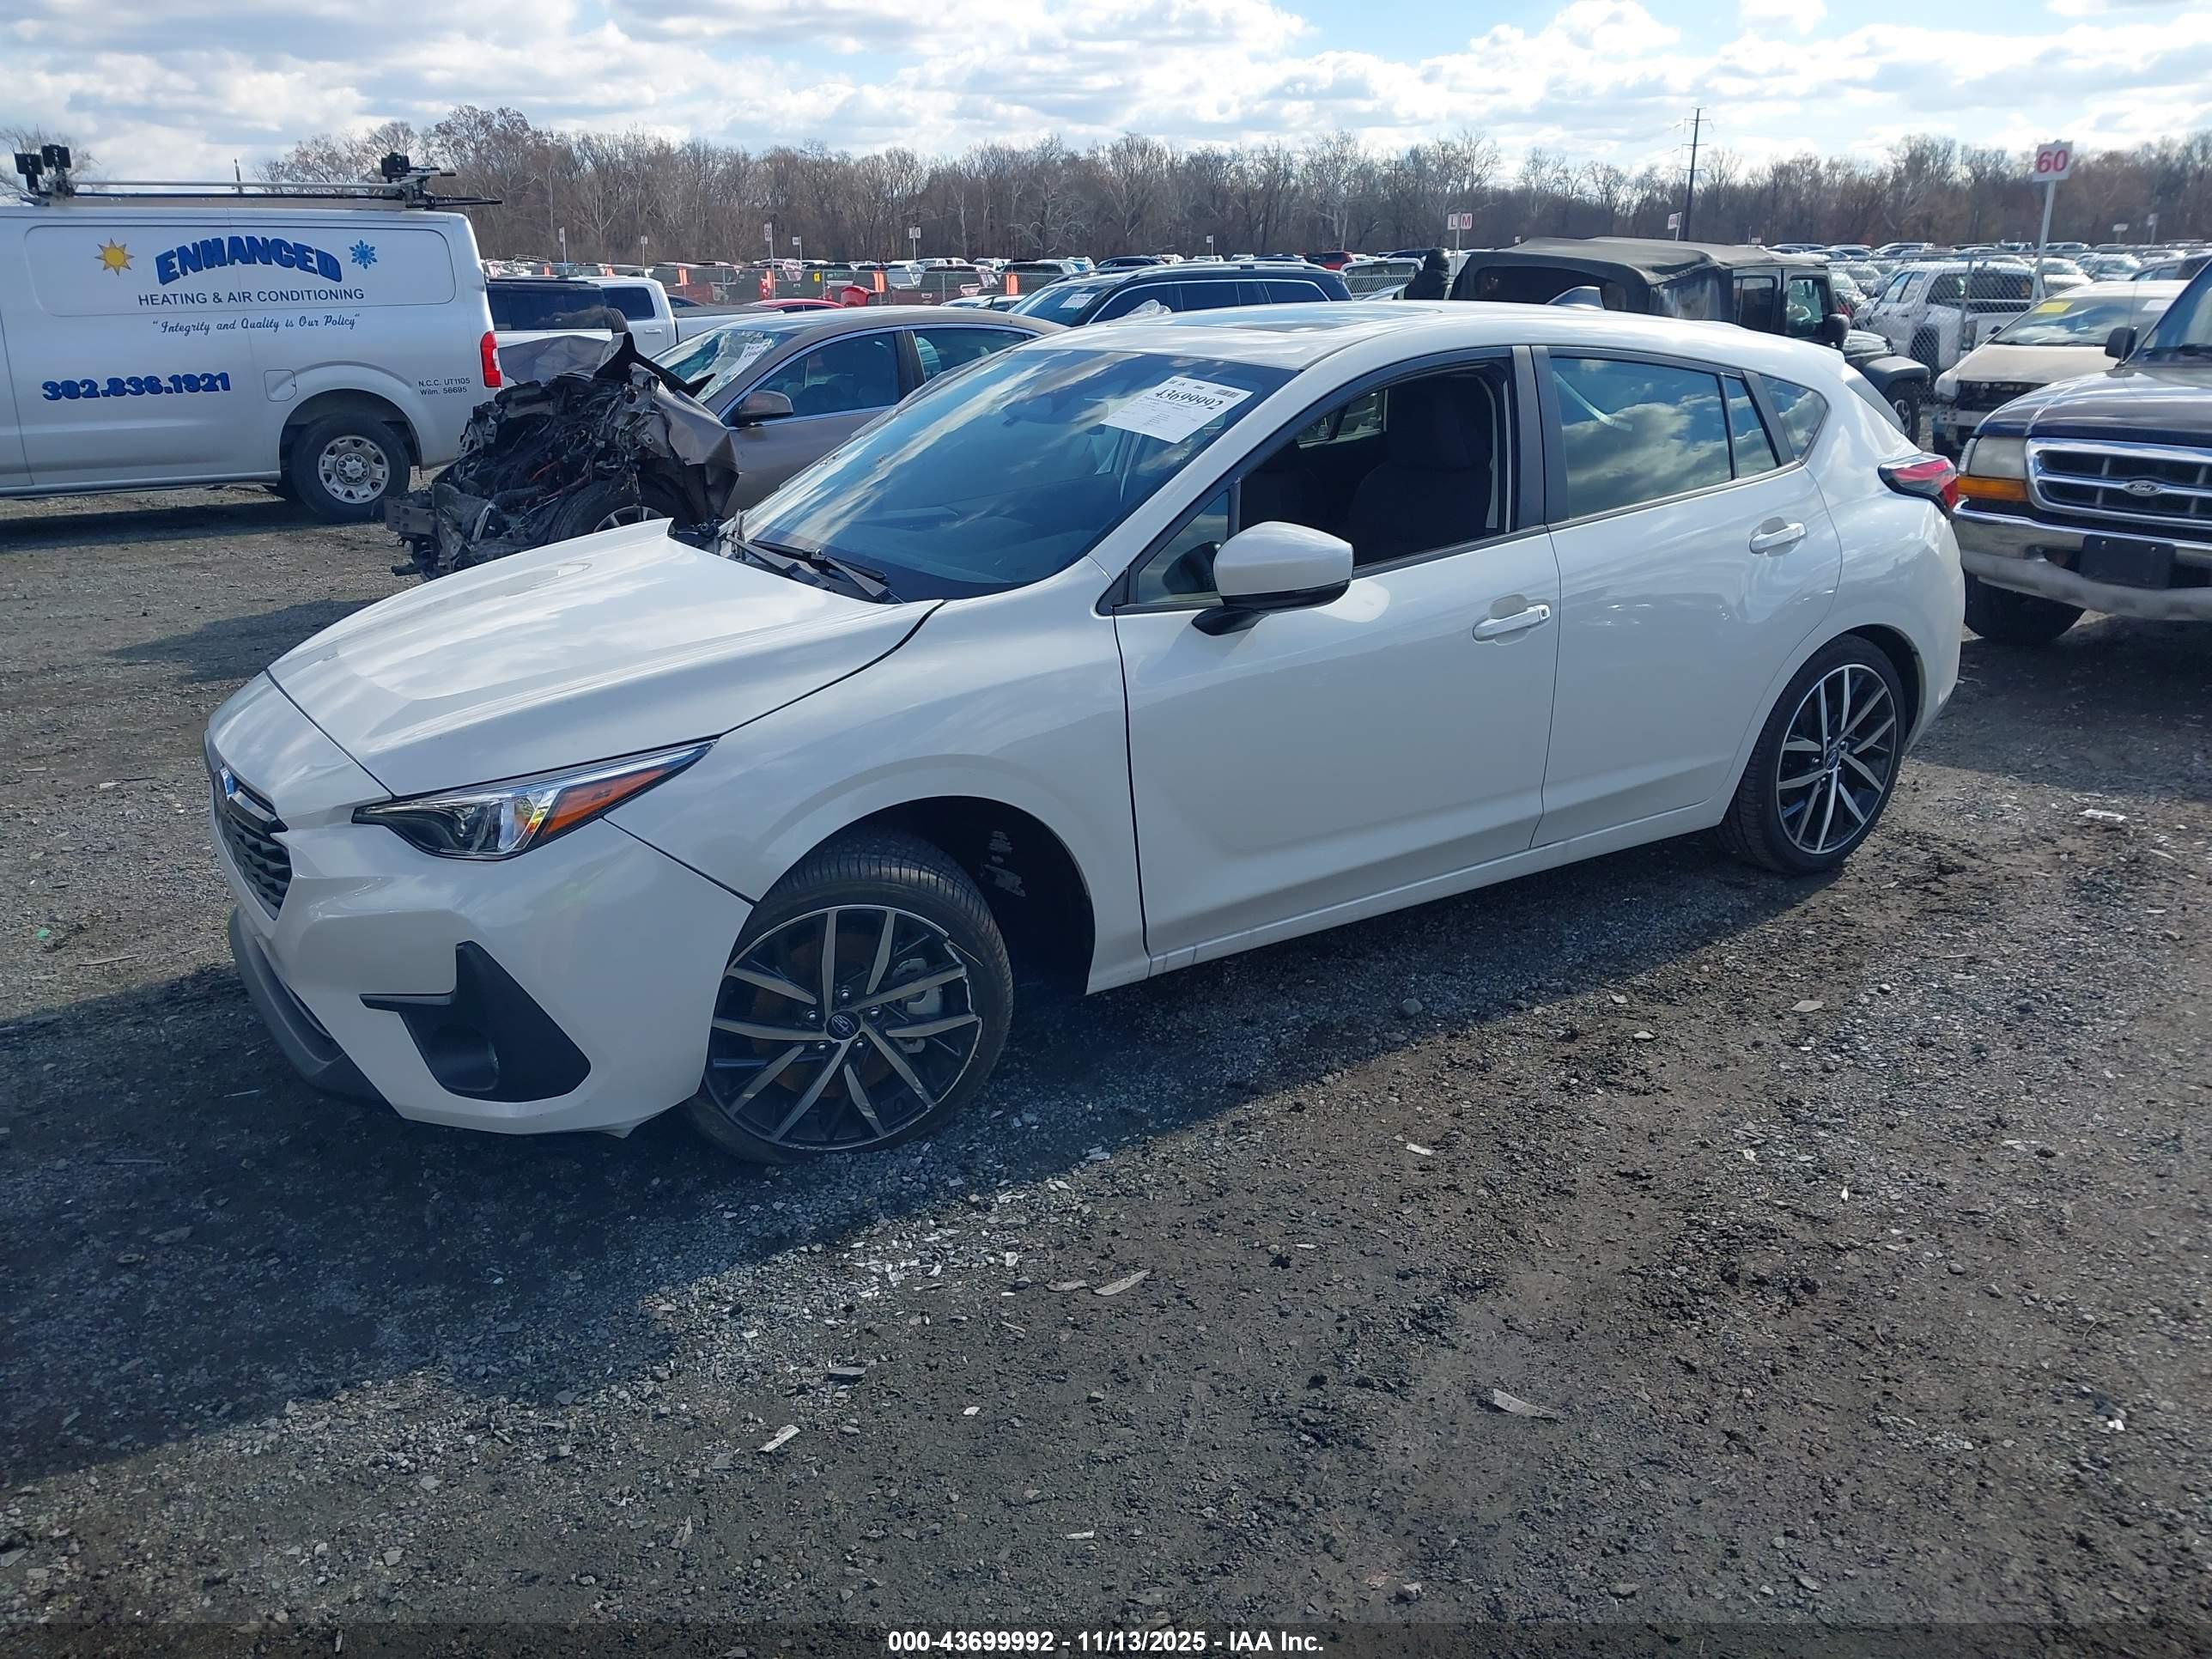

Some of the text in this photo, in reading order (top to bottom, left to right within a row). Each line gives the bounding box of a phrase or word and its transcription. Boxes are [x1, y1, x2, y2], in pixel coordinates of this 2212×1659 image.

[2037, 149, 2069, 173] 60
[1462, 216, 1471, 228] M
[155, 236, 342, 286] ENHANCED
[138, 288, 364, 306] HEATING & AIR CONDITIONING
[216, 319, 236, 331] and
[241, 317, 279, 332] Quality
[285, 319, 294, 328] is
[299, 315, 319, 327] Our
[42, 372, 230, 400] 302.836.1921
[1154, 388, 1224, 410] 43699992
